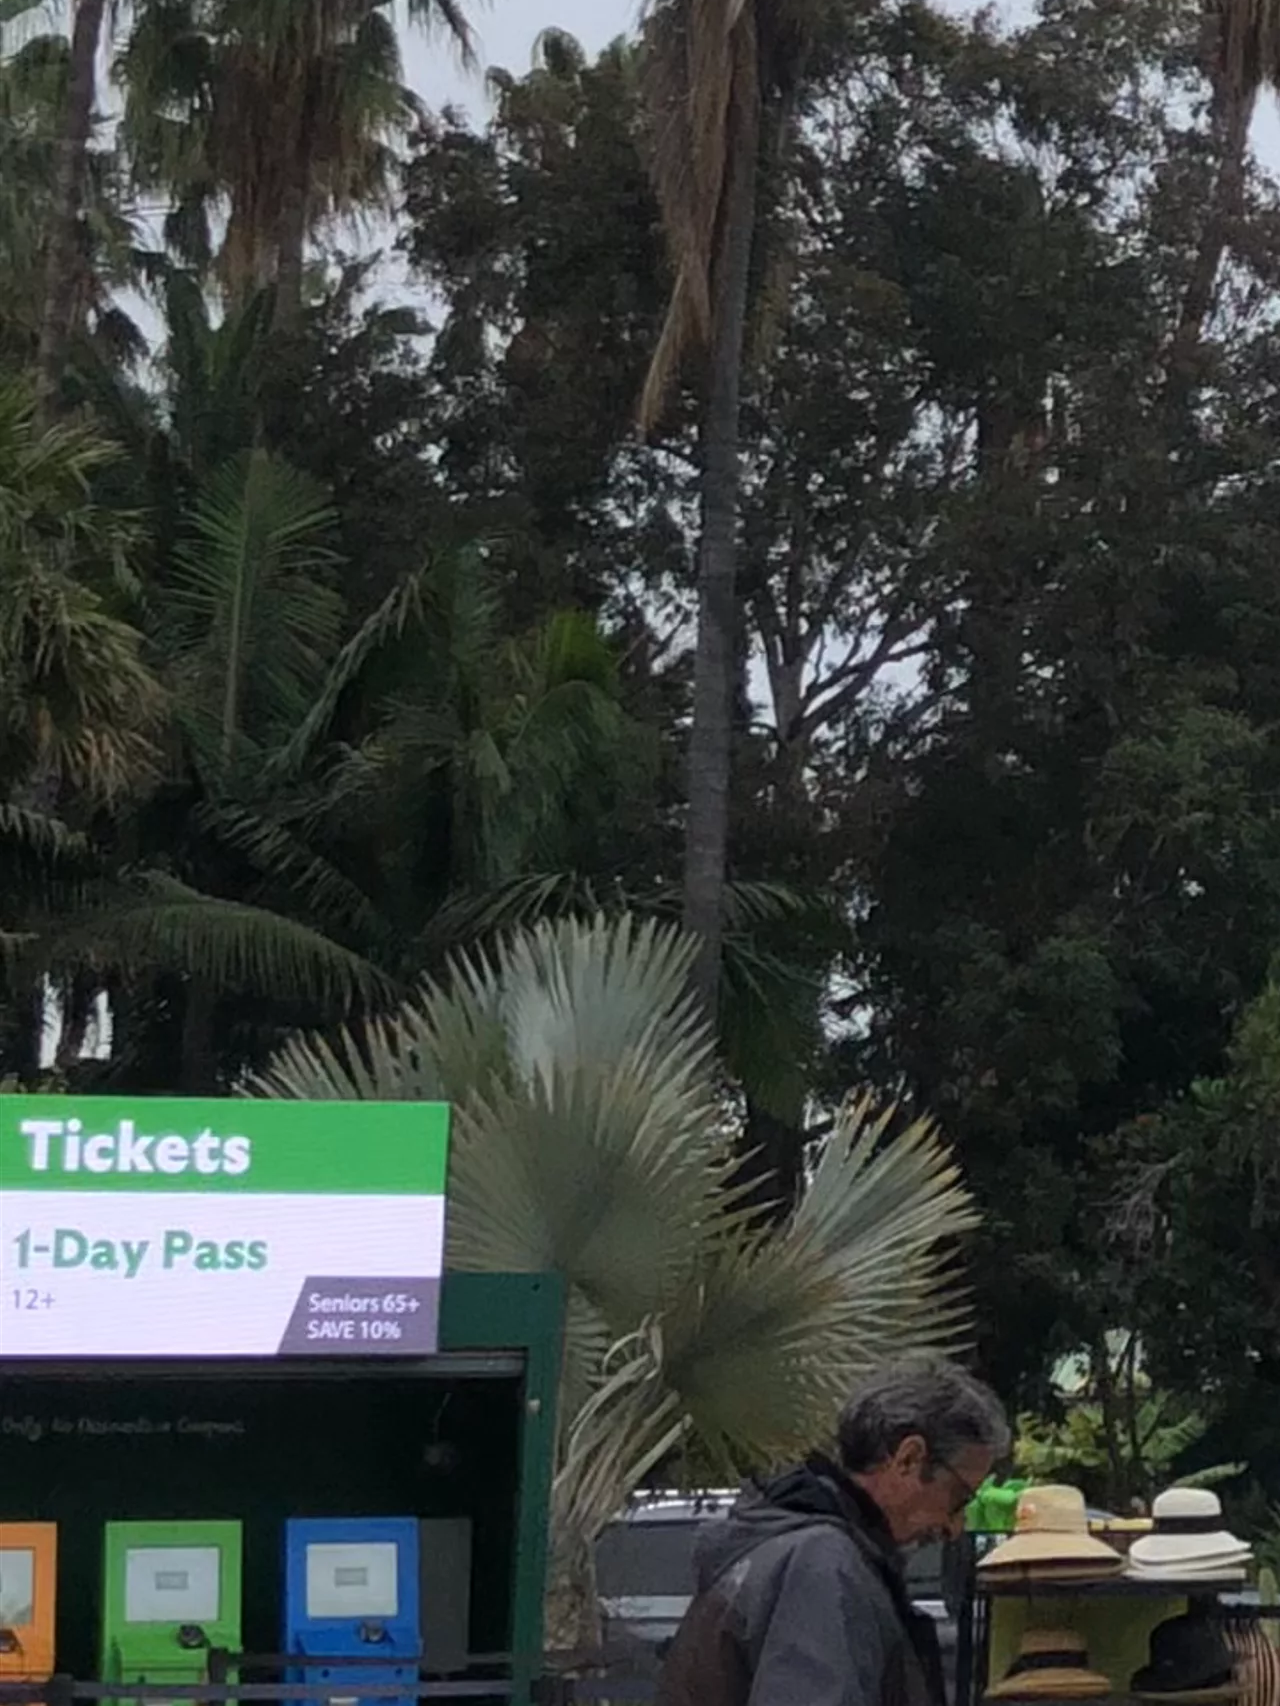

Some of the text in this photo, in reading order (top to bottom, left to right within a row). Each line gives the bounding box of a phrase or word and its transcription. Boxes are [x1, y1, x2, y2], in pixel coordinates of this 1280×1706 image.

[20, 1117, 251, 1174] Tickets
[13, 1227, 268, 1279] 1-Day Pass
[13, 1288, 56, 1310] 12+
[308, 1292, 420, 1314] Seniors 65+
[306, 1319, 401, 1340] SAVE 10%
